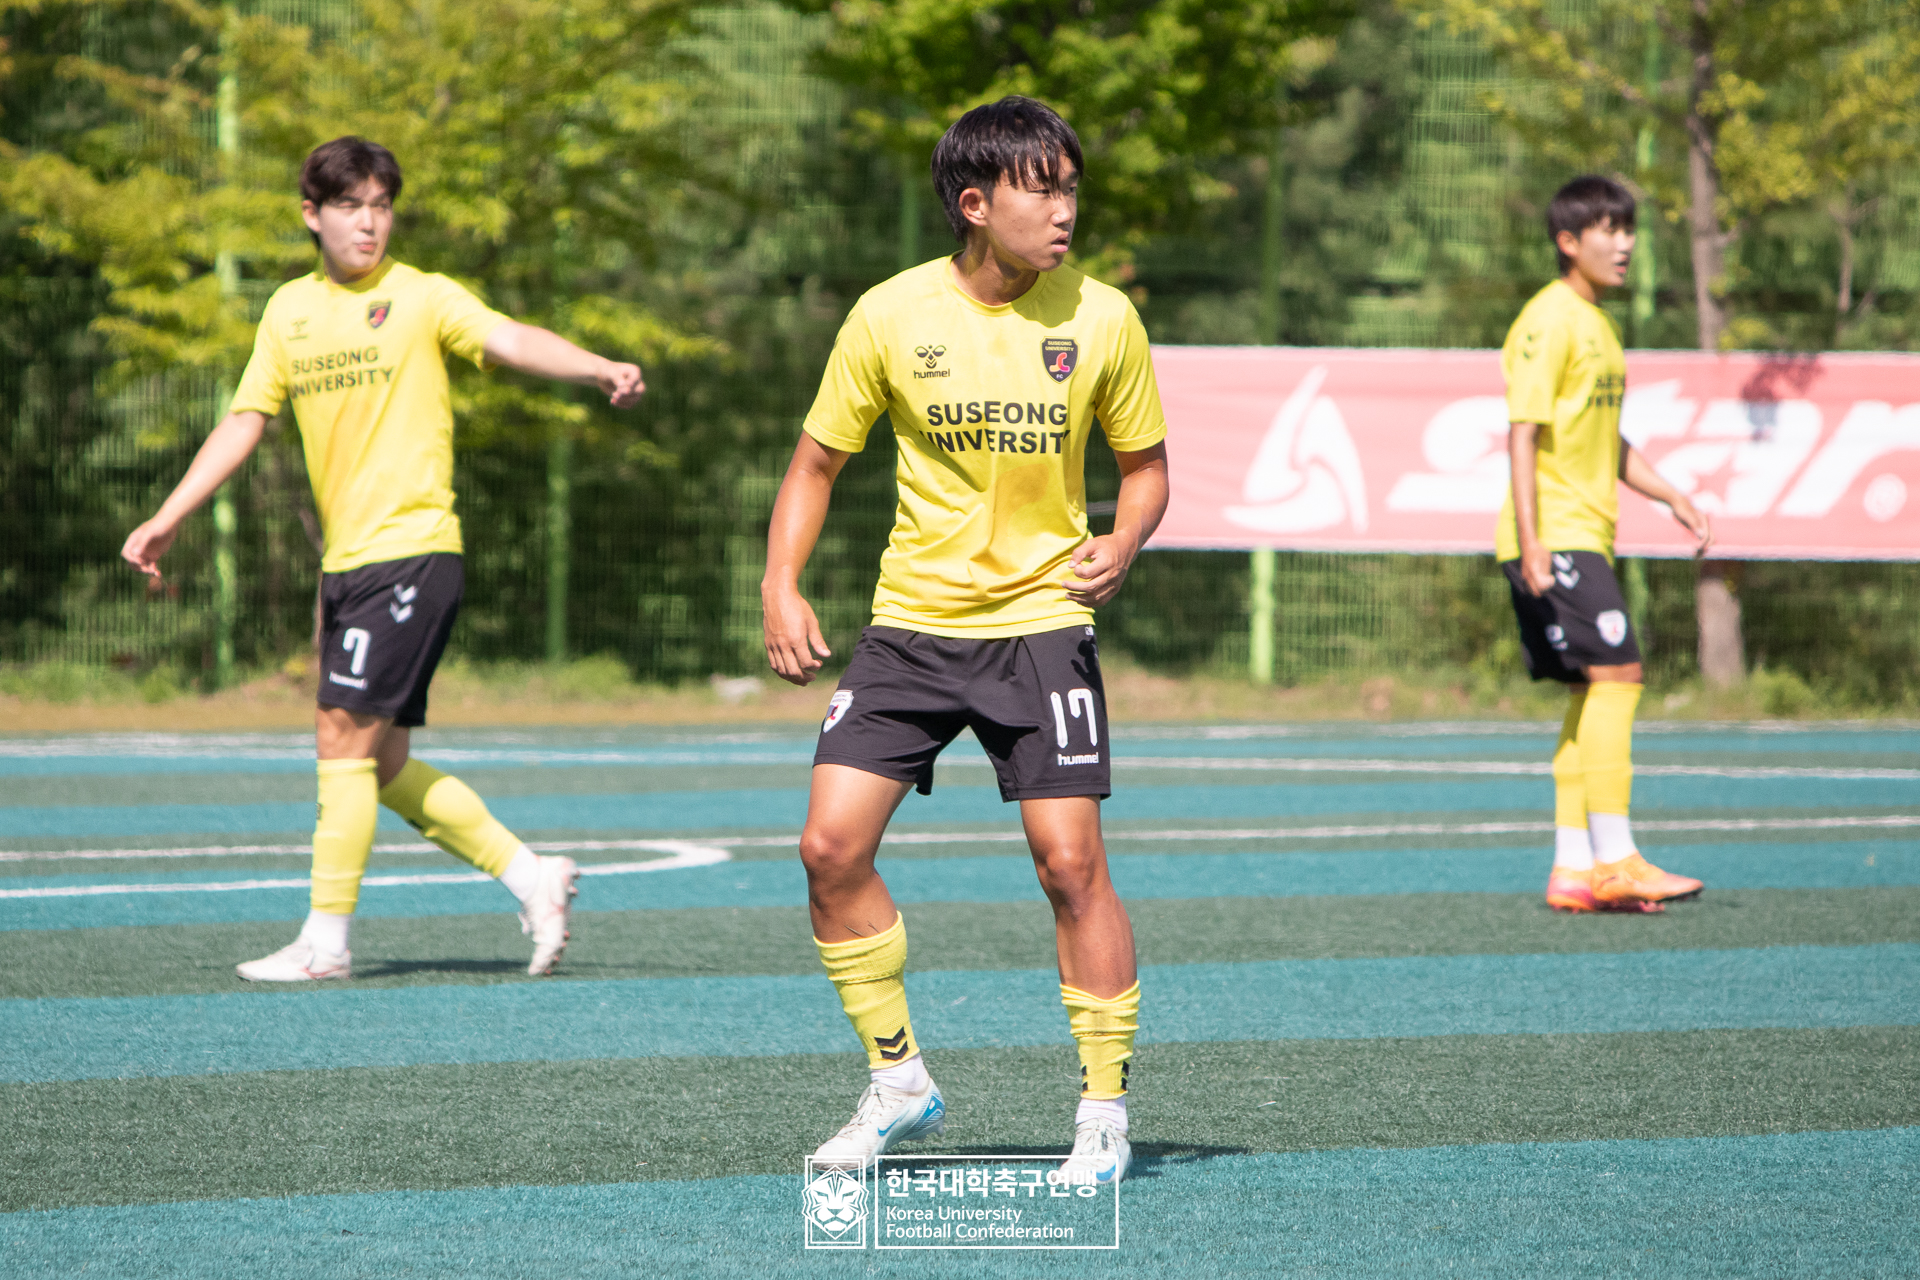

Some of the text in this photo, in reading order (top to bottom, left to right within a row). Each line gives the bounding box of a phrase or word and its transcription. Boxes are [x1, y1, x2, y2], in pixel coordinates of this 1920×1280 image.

[292, 346, 378, 375] SUSEONG
[913, 369, 950, 379] hummel
[927, 401, 1067, 426] SUSEONG
[342, 627, 370, 675] 7
[1050, 688, 1098, 748] 17
[1057, 752, 1099, 766] hummel
